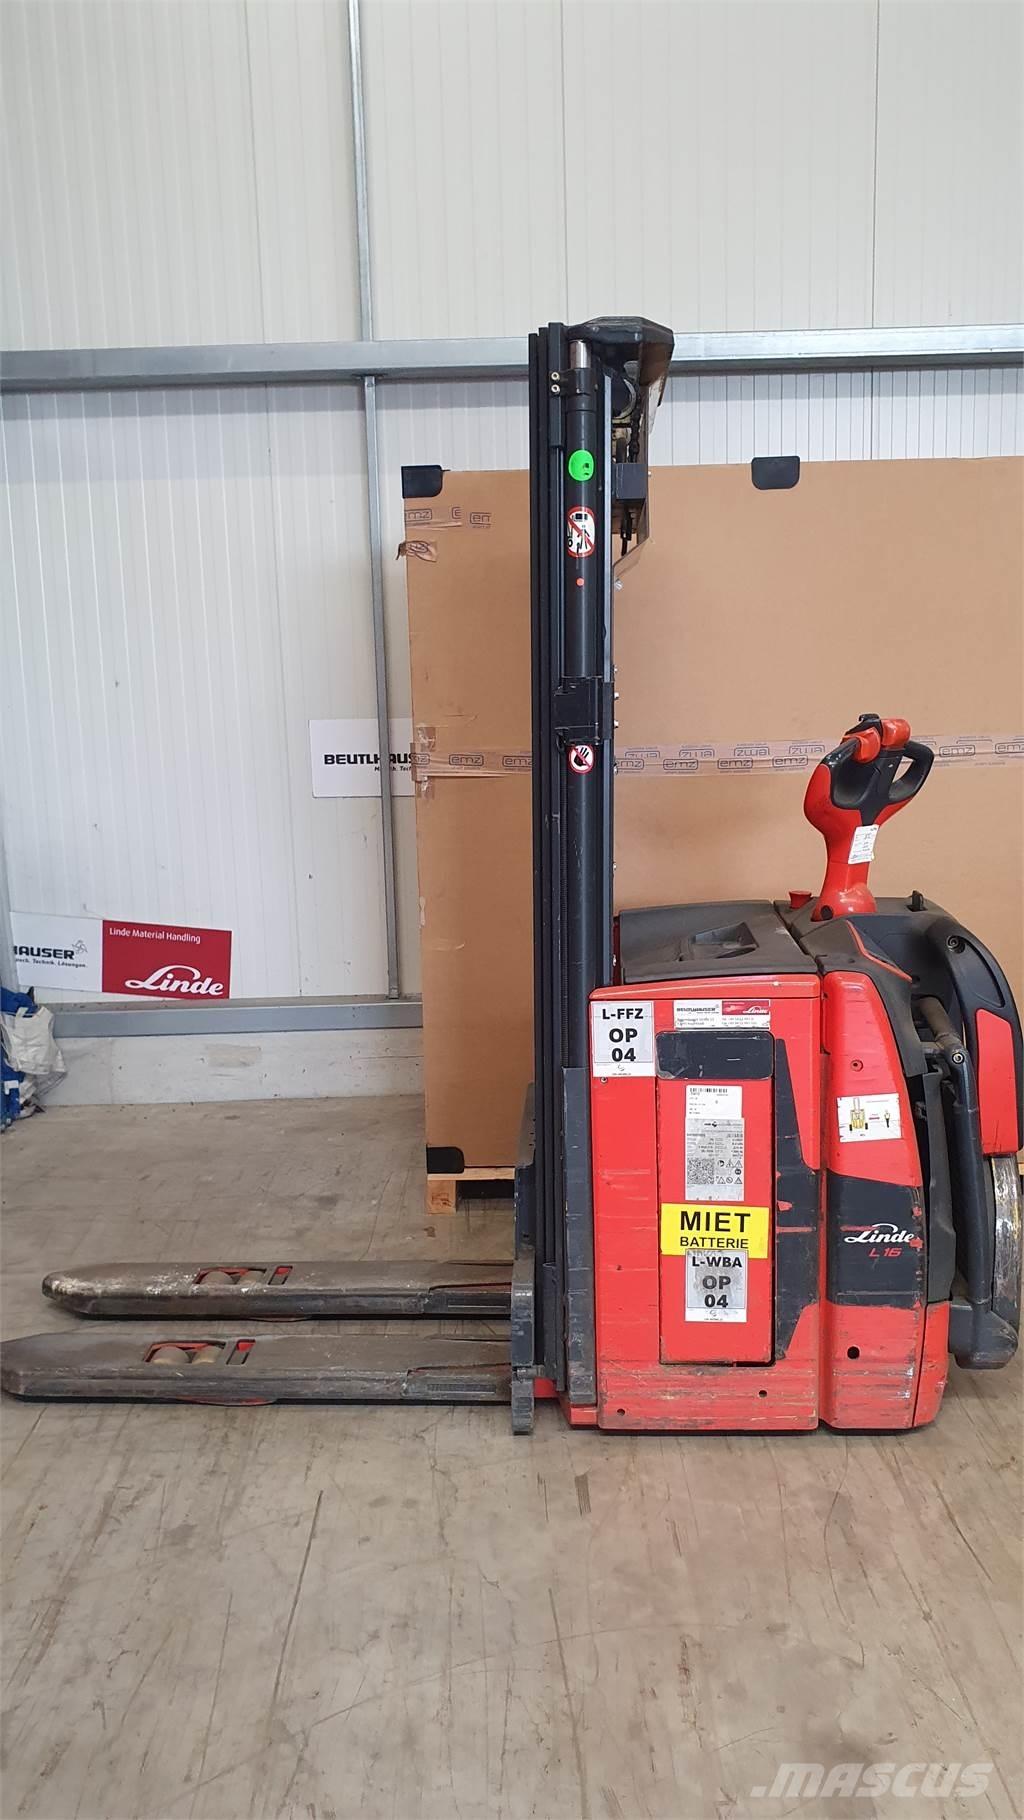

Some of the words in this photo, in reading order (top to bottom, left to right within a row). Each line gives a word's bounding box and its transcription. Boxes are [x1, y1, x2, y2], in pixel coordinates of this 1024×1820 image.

[452, 756, 481, 764] emz
[720, 759, 751, 768] emz
[775, 756, 806, 766] emz
[109, 927, 131, 937] Linde
[132, 929, 165, 940] Material
[166, 932, 201, 945] Handling
[124, 964, 224, 996] Linde
[602, 1008, 644, 1020] L-FFZ
[609, 1027, 638, 1043] OP
[611, 1047, 636, 1062] 04
[680, 1210, 751, 1233] MIET
[844, 1223, 914, 1243] Linde
[680, 1236, 749, 1249] BATTERIE
[868, 1247, 880, 1257] L
[883, 1247, 903, 1257] 16
[692, 1256, 743, 1268] L-WBA
[702, 1275, 732, 1290] OP
[704, 1294, 729, 1308] 04
